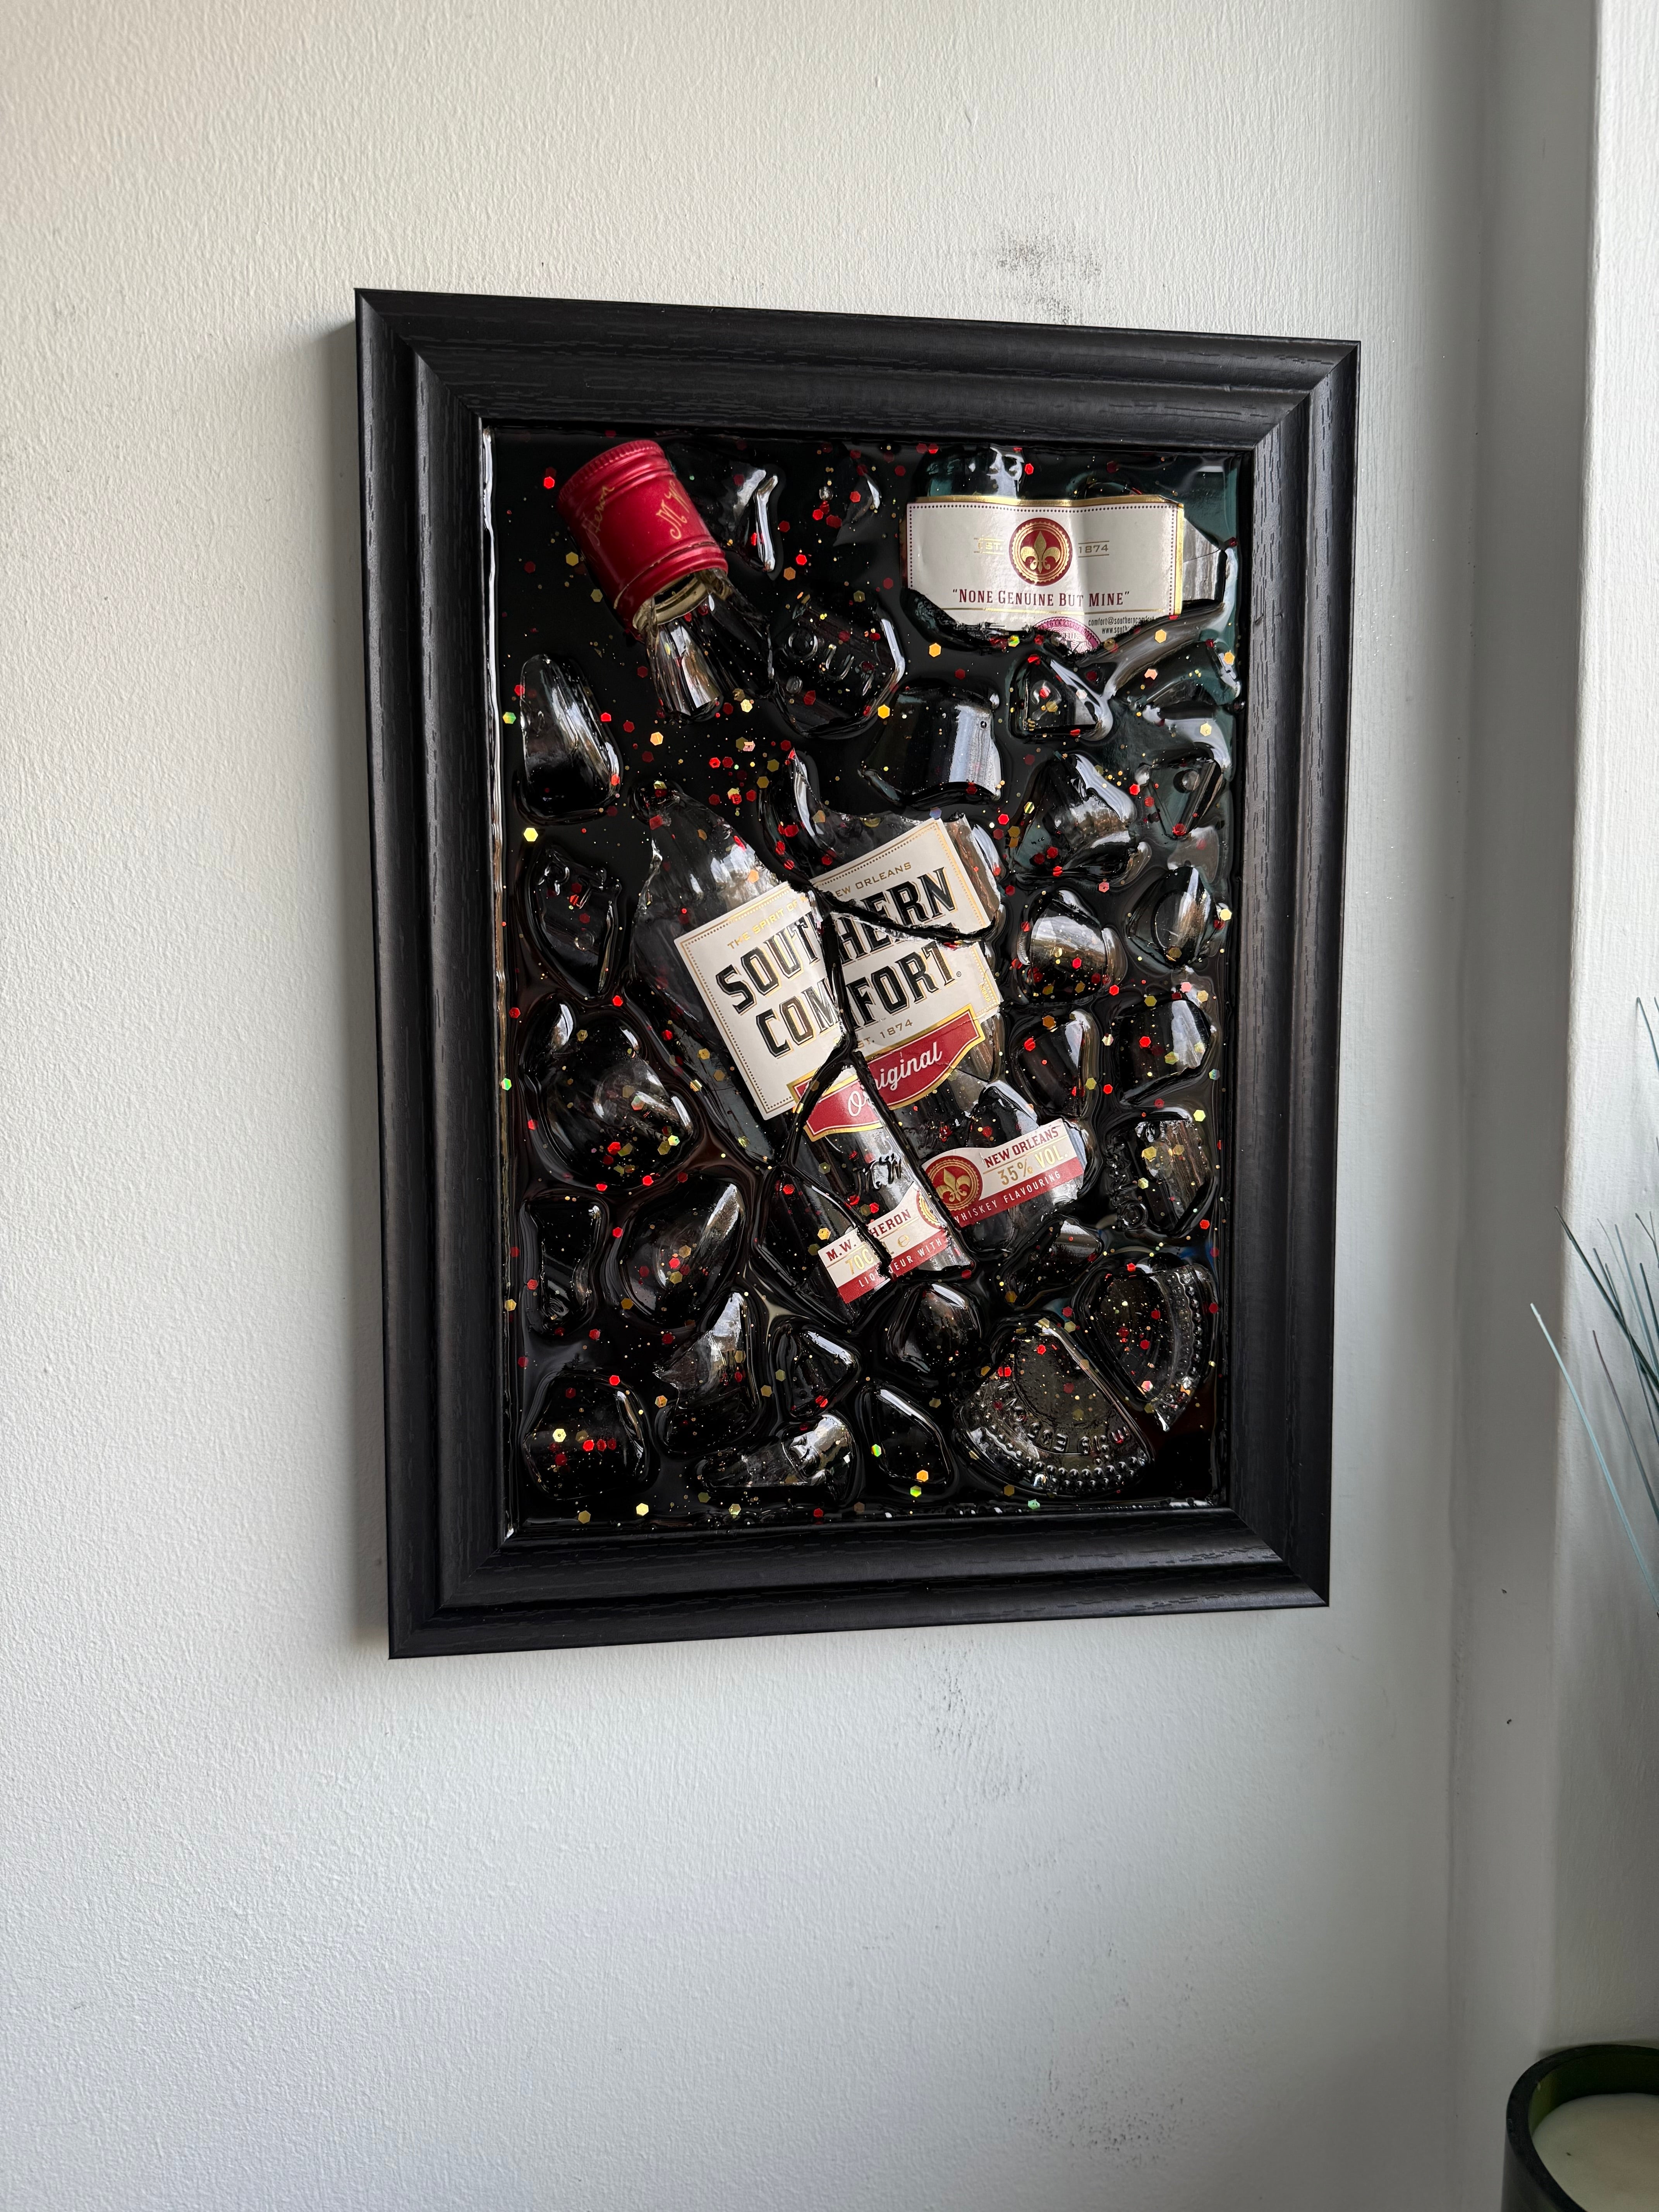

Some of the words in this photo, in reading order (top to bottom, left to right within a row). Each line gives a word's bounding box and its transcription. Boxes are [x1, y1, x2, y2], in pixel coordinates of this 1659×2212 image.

[1079, 544, 1109, 554] 1874
[998, 591, 1054, 606] GENUINE
[1059, 593, 1084, 607] BUT
[727, 932, 751, 950] THE
[752, 909, 785, 935] SPIRIT
[786, 899, 799, 912] OF
[855, 861, 912, 890] ORLEANS
[879, 1018, 913, 1039] 1874
[984, 1148, 1010, 1168] NEW
[1012, 1126, 1059, 1156] ORLEANS
[998, 1158, 1034, 1185] 35%
[1034, 1145, 1068, 1169] VOL.
[954, 1199, 998, 1223] WHISKEY
[1003, 1170, 1061, 1204] FLAVOURING
[917, 1238, 943, 1257] WITH
